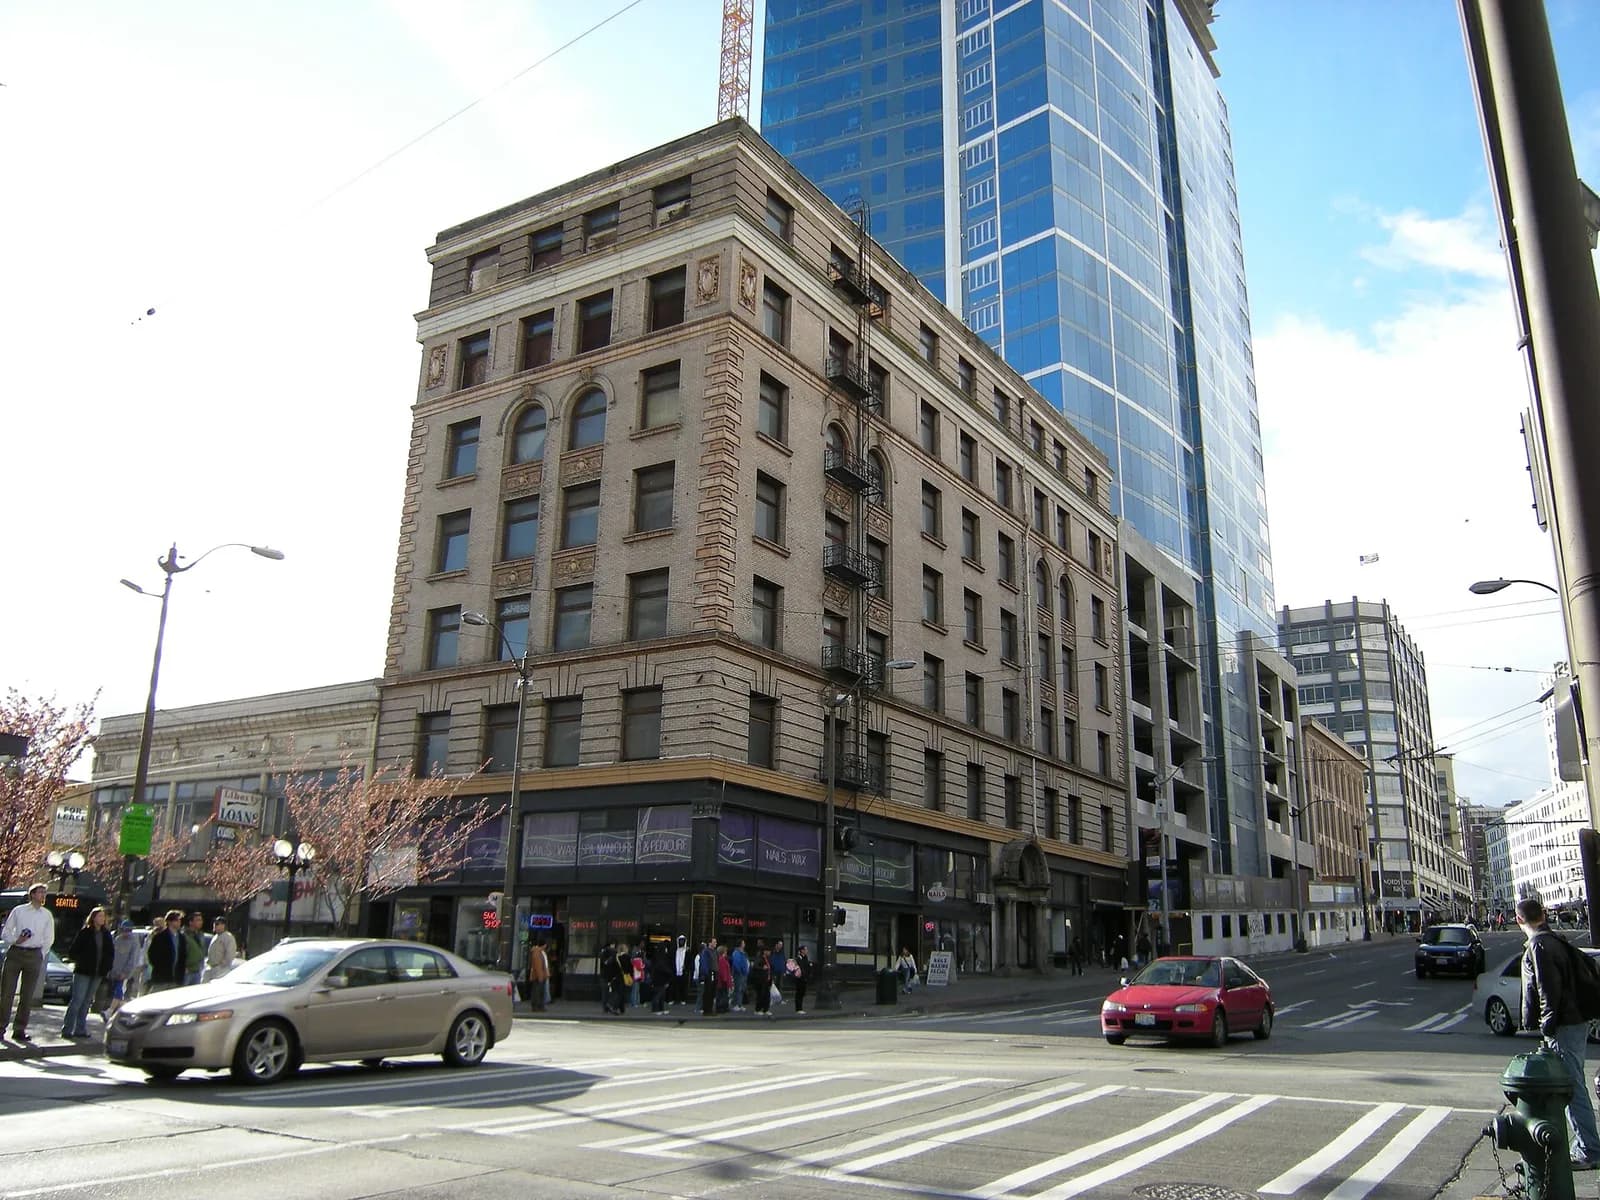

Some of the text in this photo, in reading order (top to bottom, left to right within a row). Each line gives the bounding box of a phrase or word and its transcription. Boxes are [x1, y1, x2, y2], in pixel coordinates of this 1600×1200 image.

[224, 791, 261, 806] Liberty
[527, 845, 552, 857] NAILS
[558, 844, 577, 857] WAX
[650, 838, 688, 852] PEDICURE
[766, 849, 807, 866] NAILS WAX
[928, 890, 946, 898] NAILS
[56, 898, 78, 908] SEATTLE
